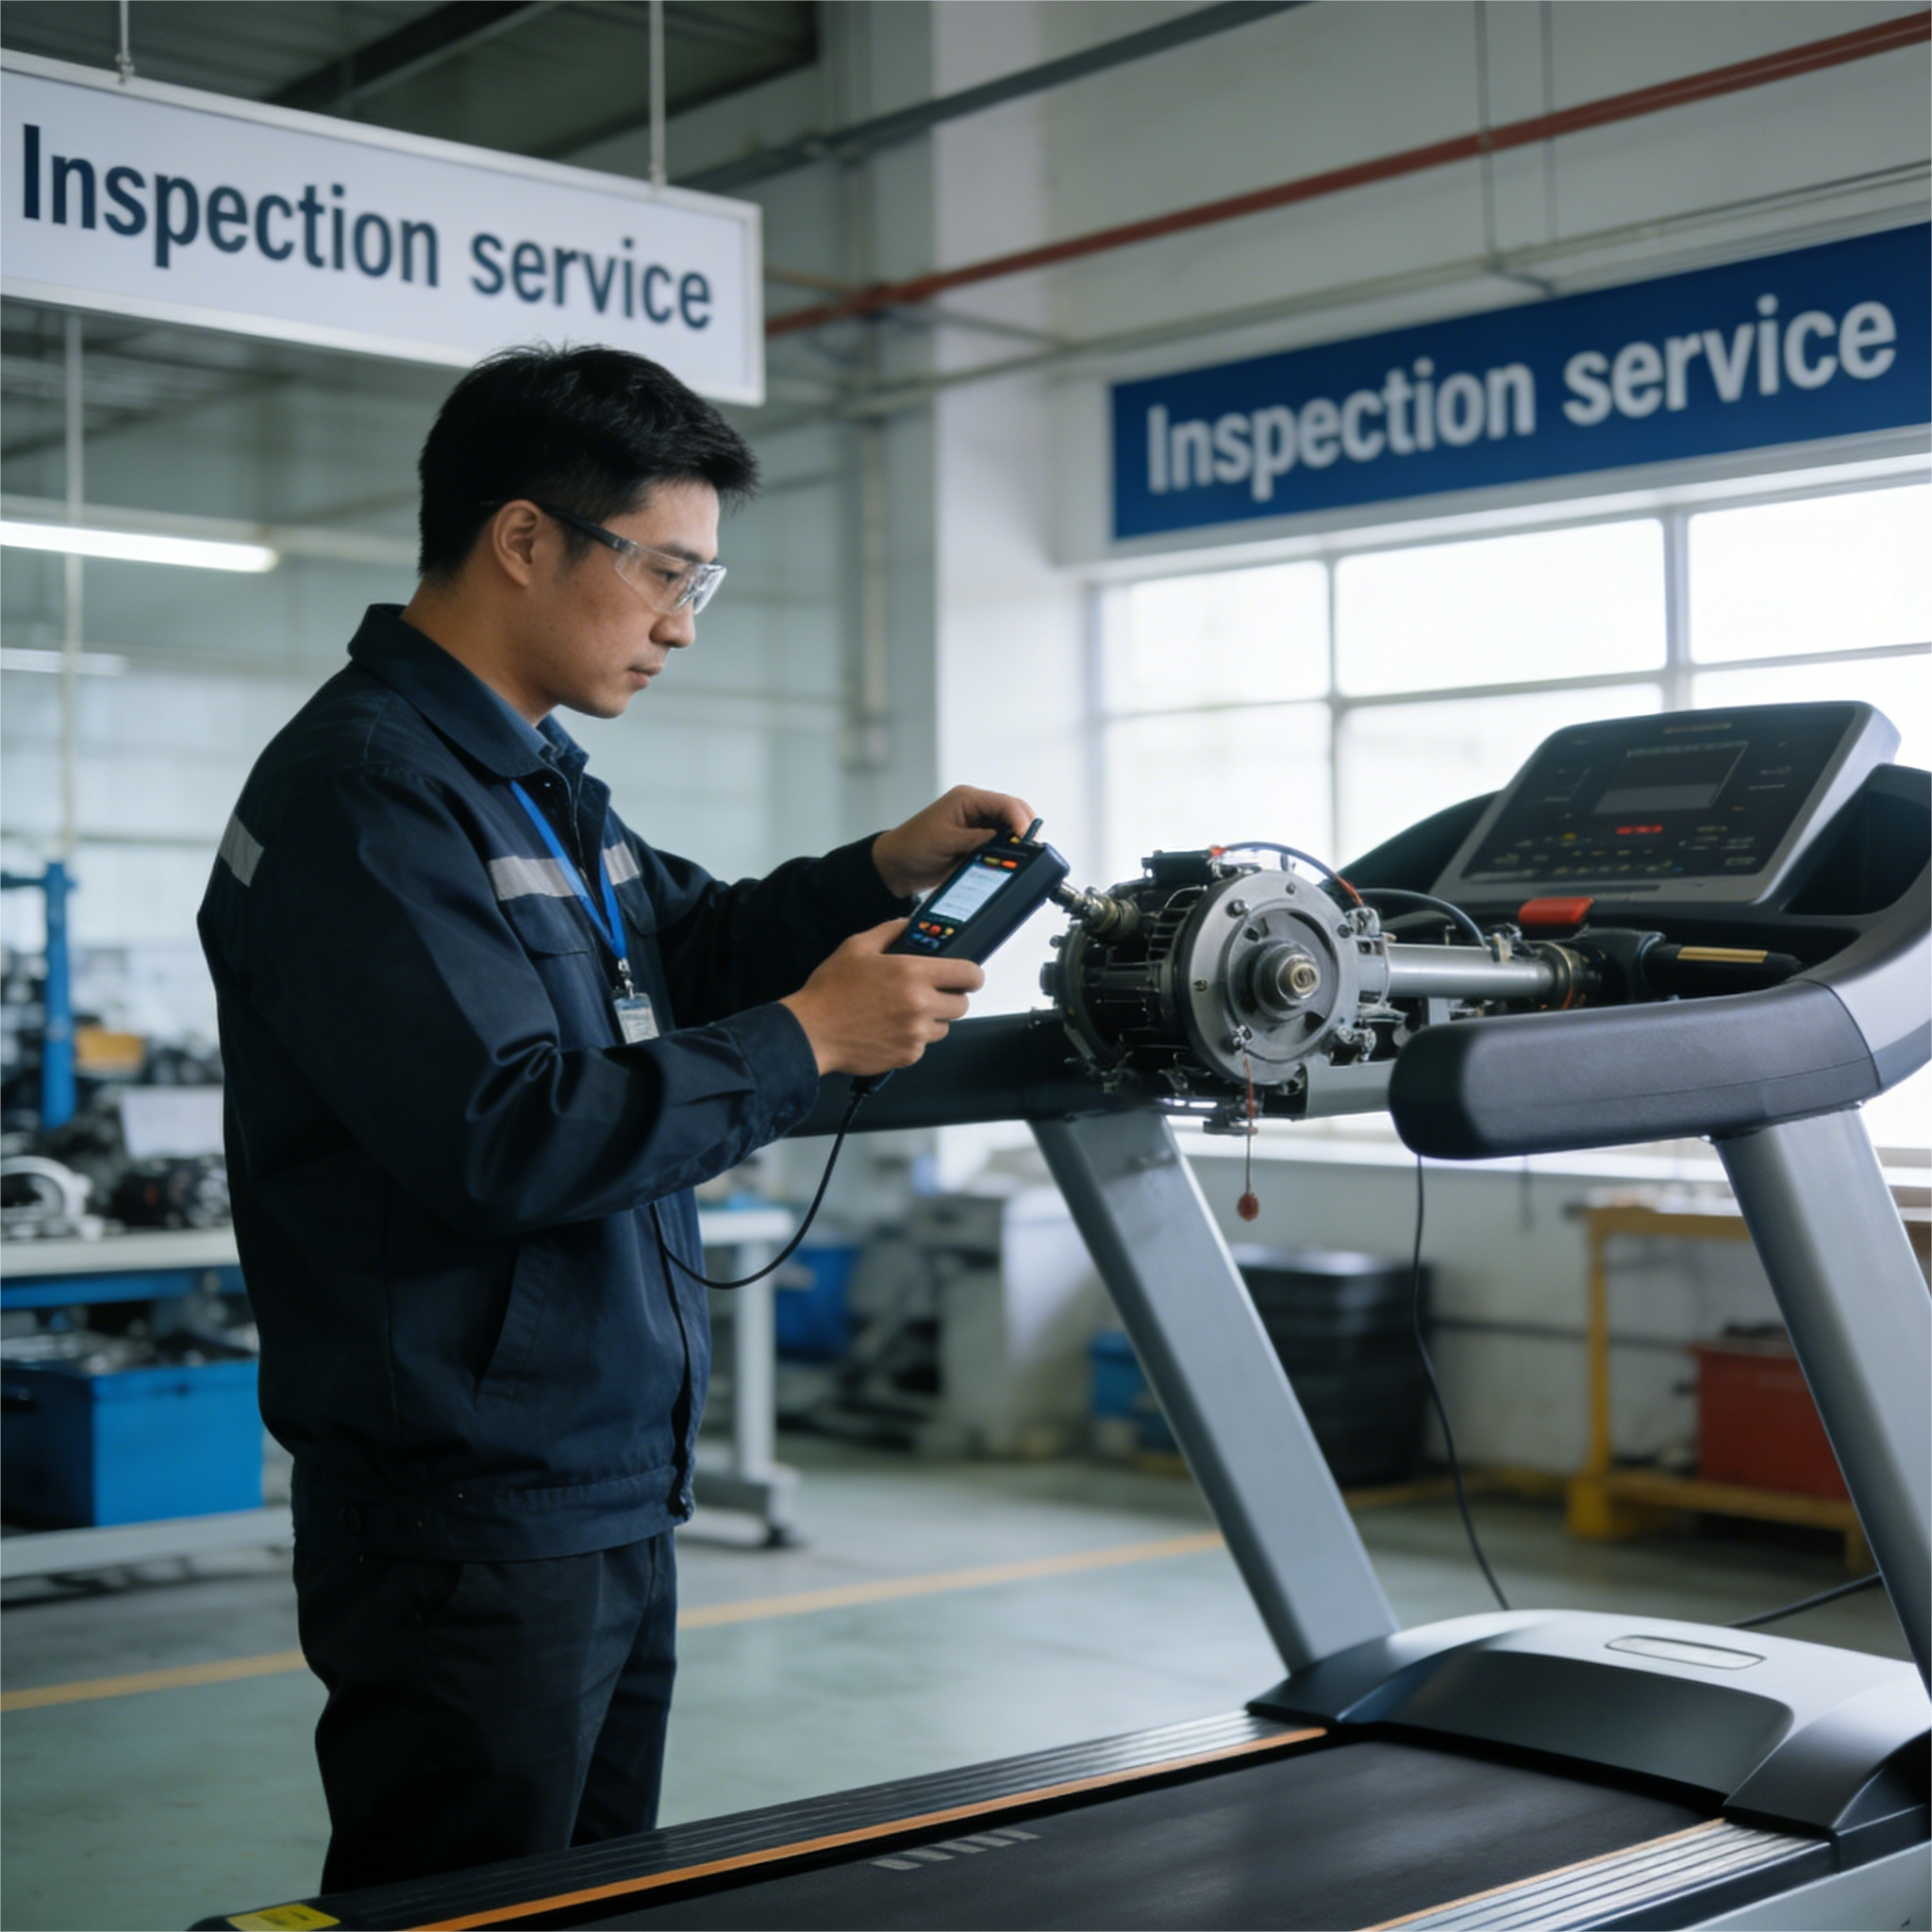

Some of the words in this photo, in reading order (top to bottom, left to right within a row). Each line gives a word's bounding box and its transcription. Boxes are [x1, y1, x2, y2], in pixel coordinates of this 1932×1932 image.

[23, 124, 439, 288] Inspection
[470, 232, 713, 330] service
[1146, 358, 1535, 502] Inspection
[1563, 293, 1896, 425] service
